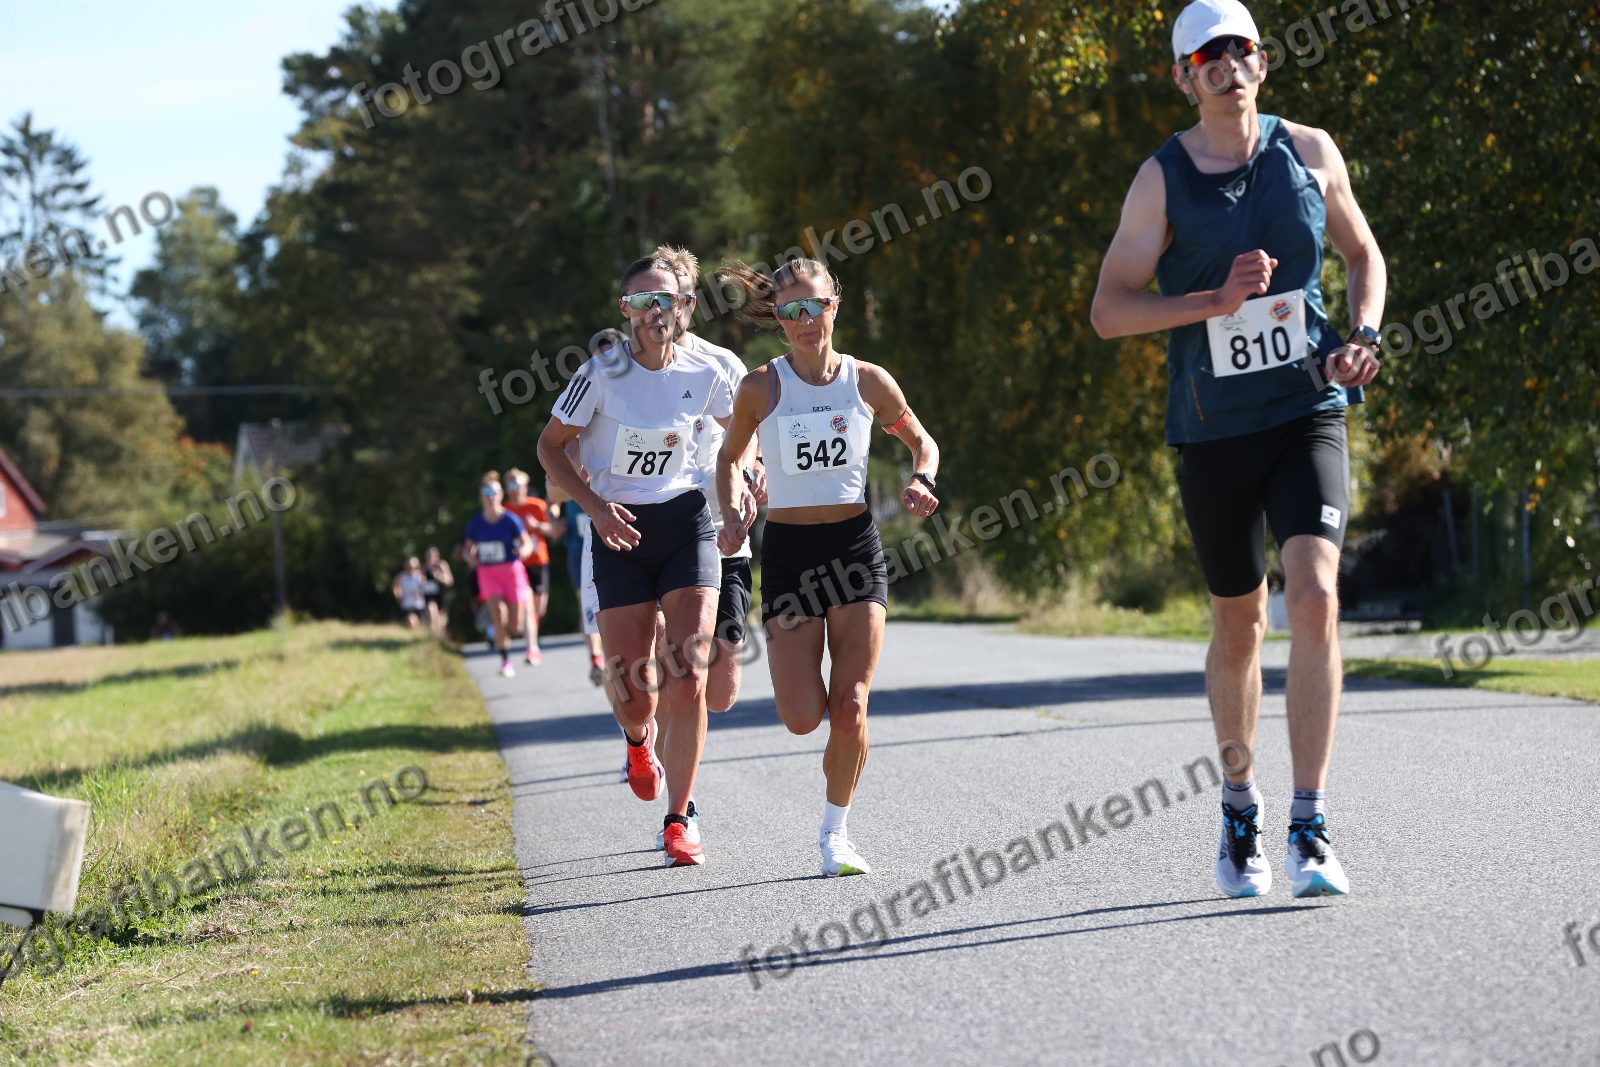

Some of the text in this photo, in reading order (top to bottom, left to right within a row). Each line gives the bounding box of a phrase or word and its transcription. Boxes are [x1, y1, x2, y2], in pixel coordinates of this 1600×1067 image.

[1230, 326, 1290, 370] 810
[627, 450, 673, 476] 787
[796, 437, 847, 471] 542
